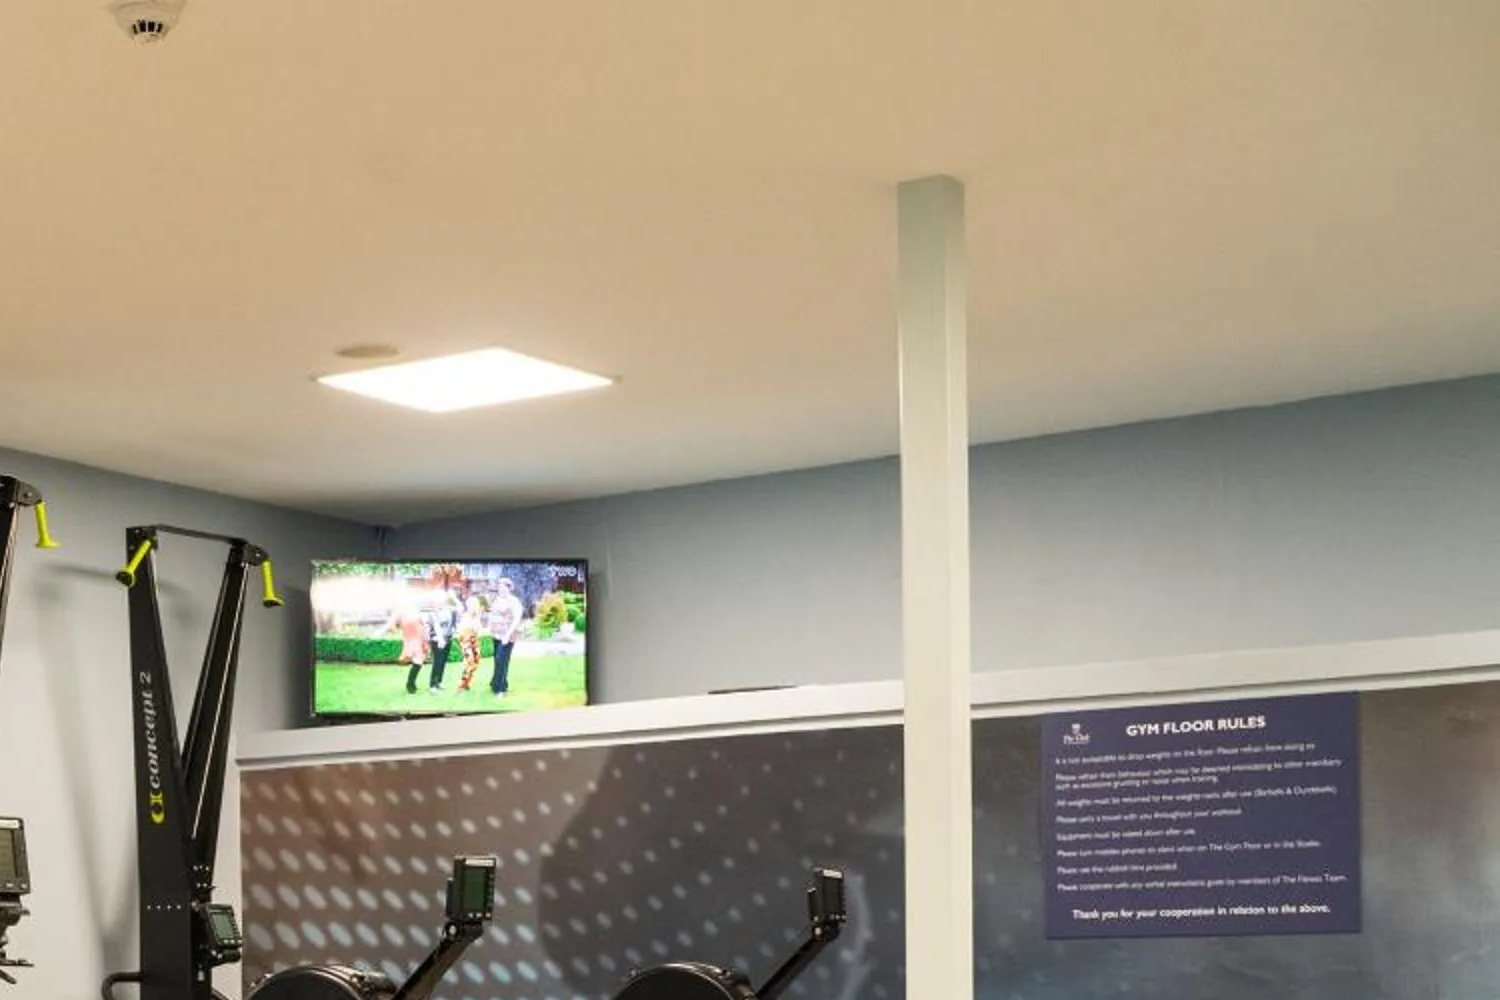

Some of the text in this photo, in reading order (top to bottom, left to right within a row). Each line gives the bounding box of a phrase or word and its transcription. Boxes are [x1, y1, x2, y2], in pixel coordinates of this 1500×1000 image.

[139, 671, 161, 789] concept 2
[1125, 715, 1267, 737] GYM FLOOR RULES
[1072, 908, 1100, 920] Thank
